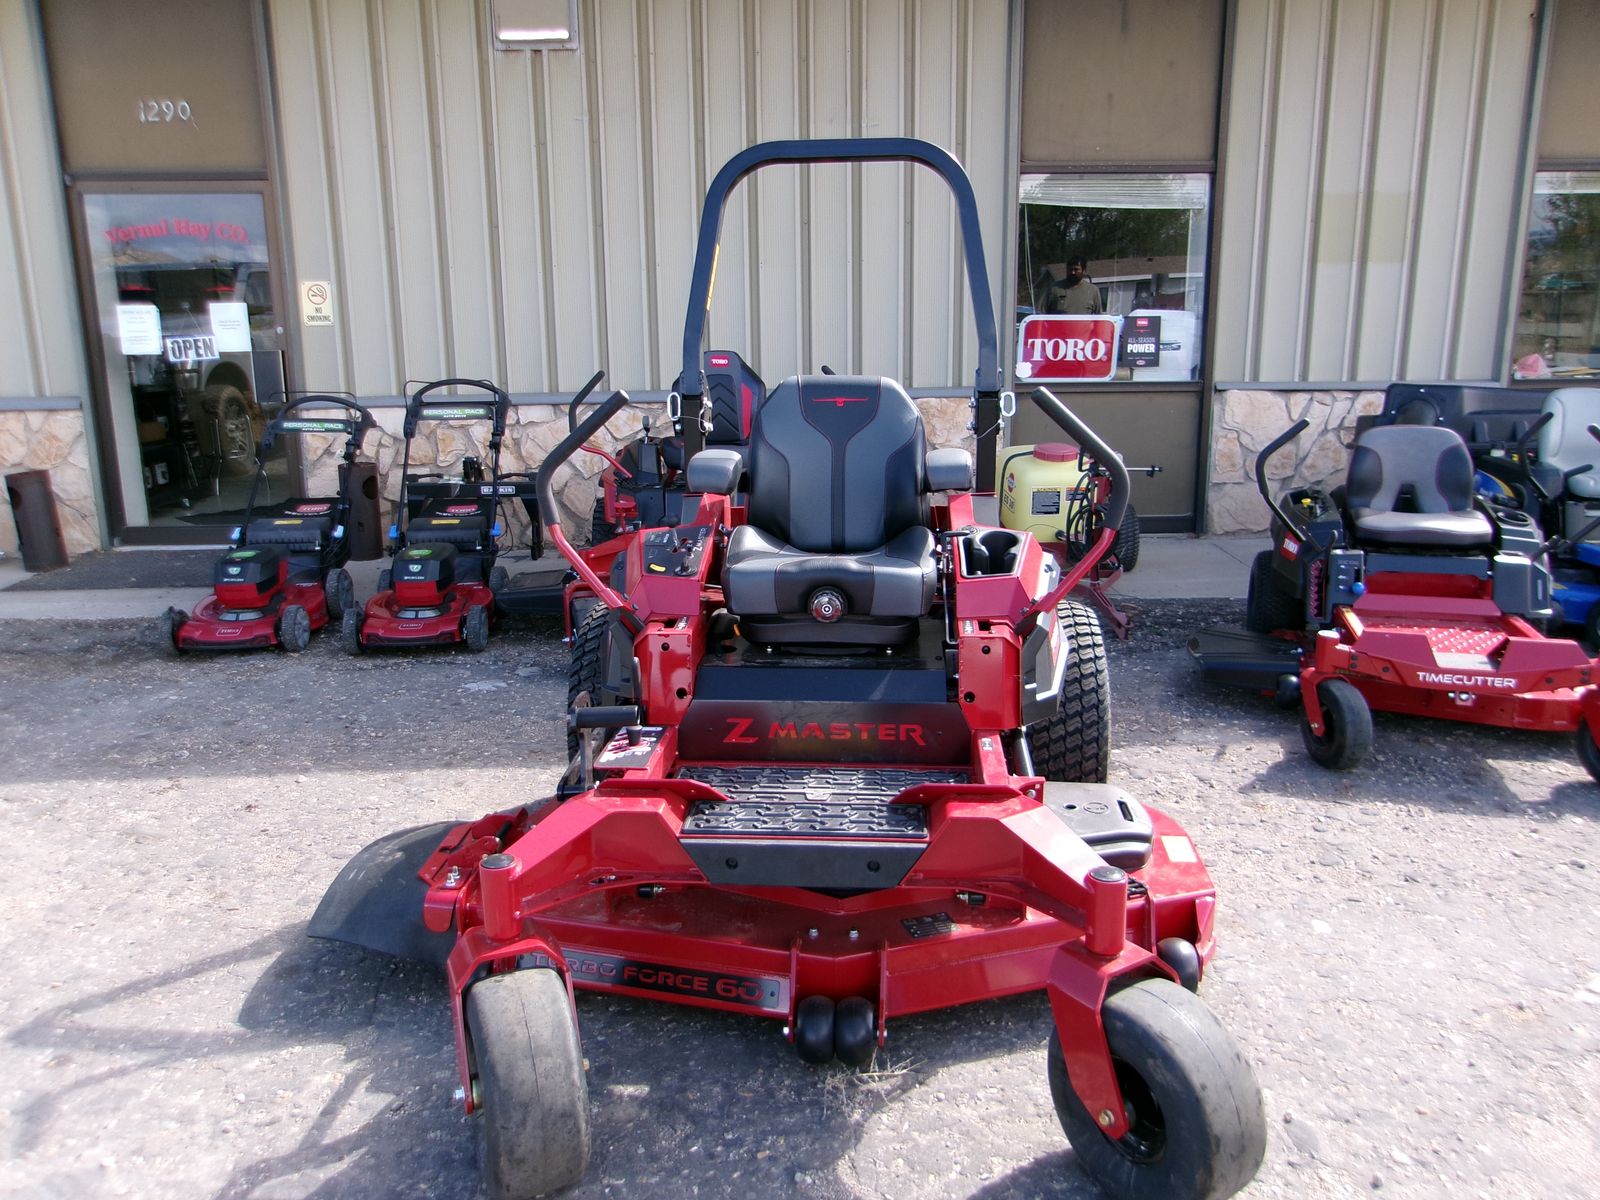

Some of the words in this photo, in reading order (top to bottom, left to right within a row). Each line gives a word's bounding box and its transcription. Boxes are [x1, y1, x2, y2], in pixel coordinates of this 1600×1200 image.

[139, 100, 191, 122] 1290
[171, 338, 216, 359] OPEN
[1027, 338, 1106, 361] TORO
[1127, 344, 1155, 353] POWER
[1416, 671, 1517, 689] TIMECUTTER
[722, 718, 759, 743] Z
[768, 722, 927, 746] MASTER
[623, 965, 710, 992] FORCE
[715, 979, 764, 1001] 60
